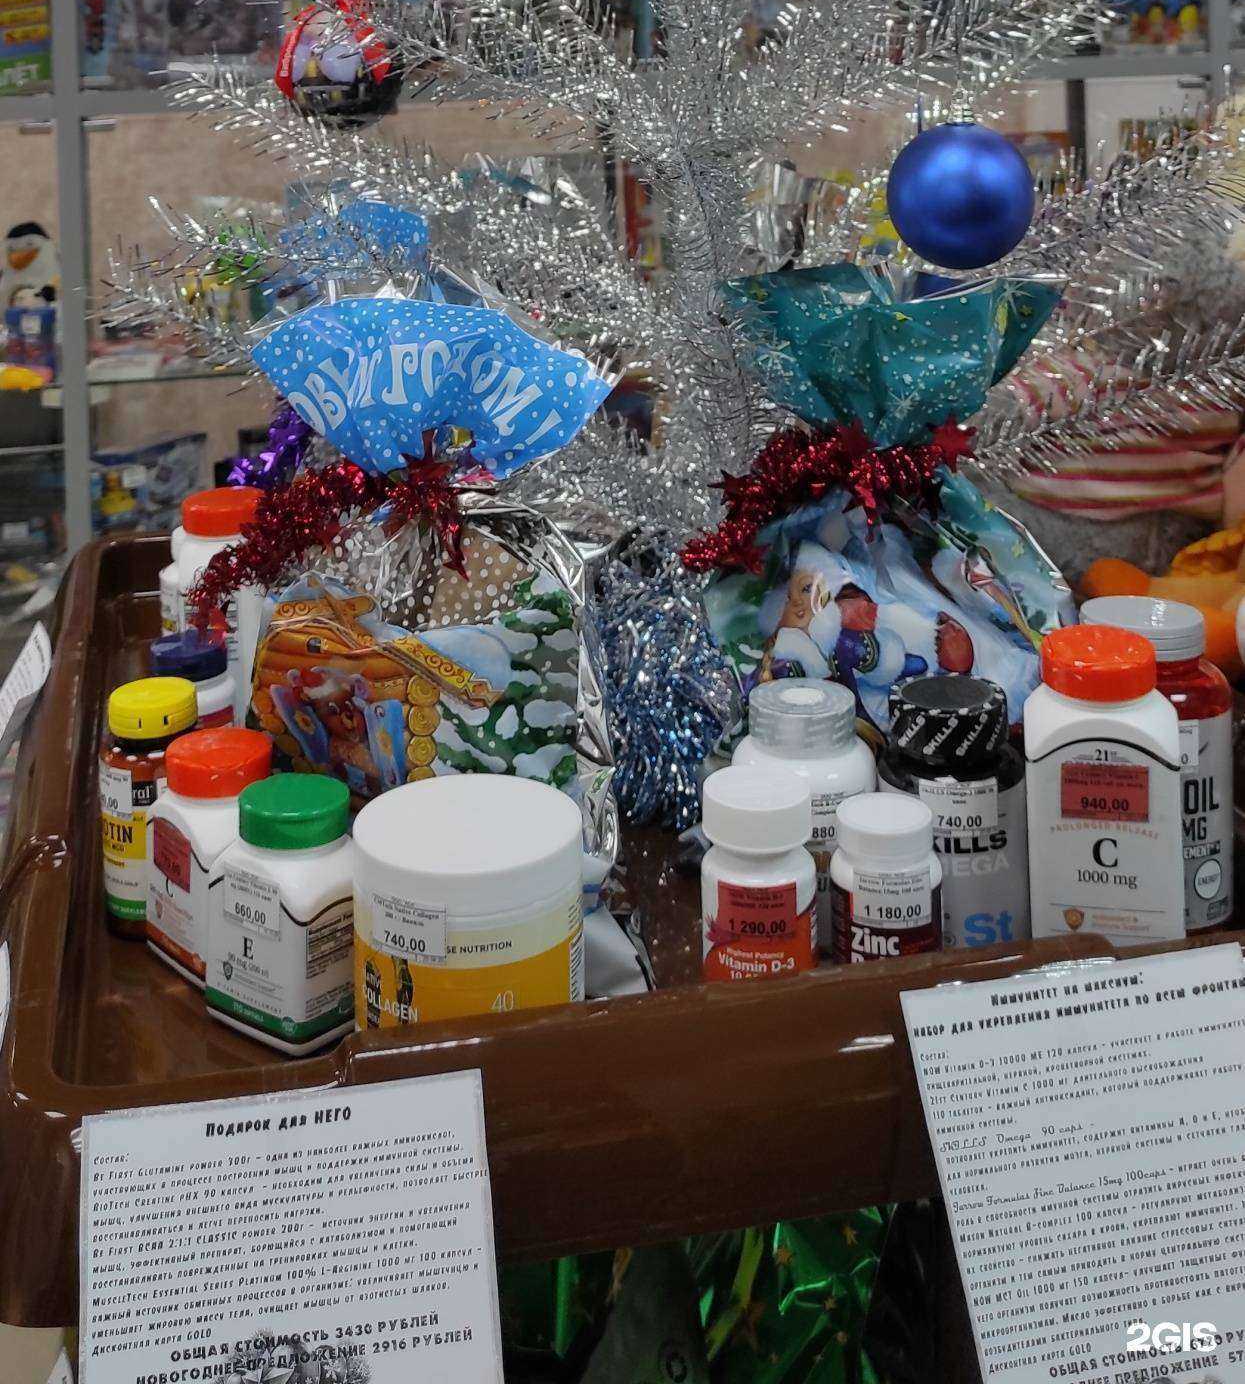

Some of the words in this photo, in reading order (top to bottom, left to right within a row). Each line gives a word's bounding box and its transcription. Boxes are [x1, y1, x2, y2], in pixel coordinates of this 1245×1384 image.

[922, 716, 958, 756] SKILLS
[955, 713, 988, 757] SKILLS
[1081, 796, 1130, 813] 940,00
[1183, 776, 1219, 815] OIL
[937, 815, 982, 830] 740,00
[1092, 837, 1118, 868] C
[1077, 868, 1110, 884] 1000
[1113, 874, 1138, 890] mg
[235, 902, 266, 925] 660,00
[877, 904, 922, 921] 180,00
[243, 936, 254, 960] E
[384, 930, 426, 953] 740,00
[459, 940, 512, 954] NUTRITION
[851, 926, 900, 956] Zinc
[718, 951, 767, 973] Vitamin
[771, 957, 795, 973] D-3
[491, 990, 514, 1012] 40
[1032, 1078, 1054, 1090] 1000
[314, 1106, 351, 1124] НЕГО
[376, 1256, 400, 1268] 1000
[419, 1251, 436, 1262] 100
[171, 1342, 229, 1362] ОБЩАЯ
[234, 1327, 329, 1353] СТОИМОСТЬ
[335, 1323, 373, 1339] 3430
[377, 1310, 439, 1333] РУБЛЕЙ
[372, 1338, 407, 1354] 2916
[412, 1325, 472, 1348] РУБЛЕЙ
[1050, 1354, 1098, 1378] ОБЩАЯ
